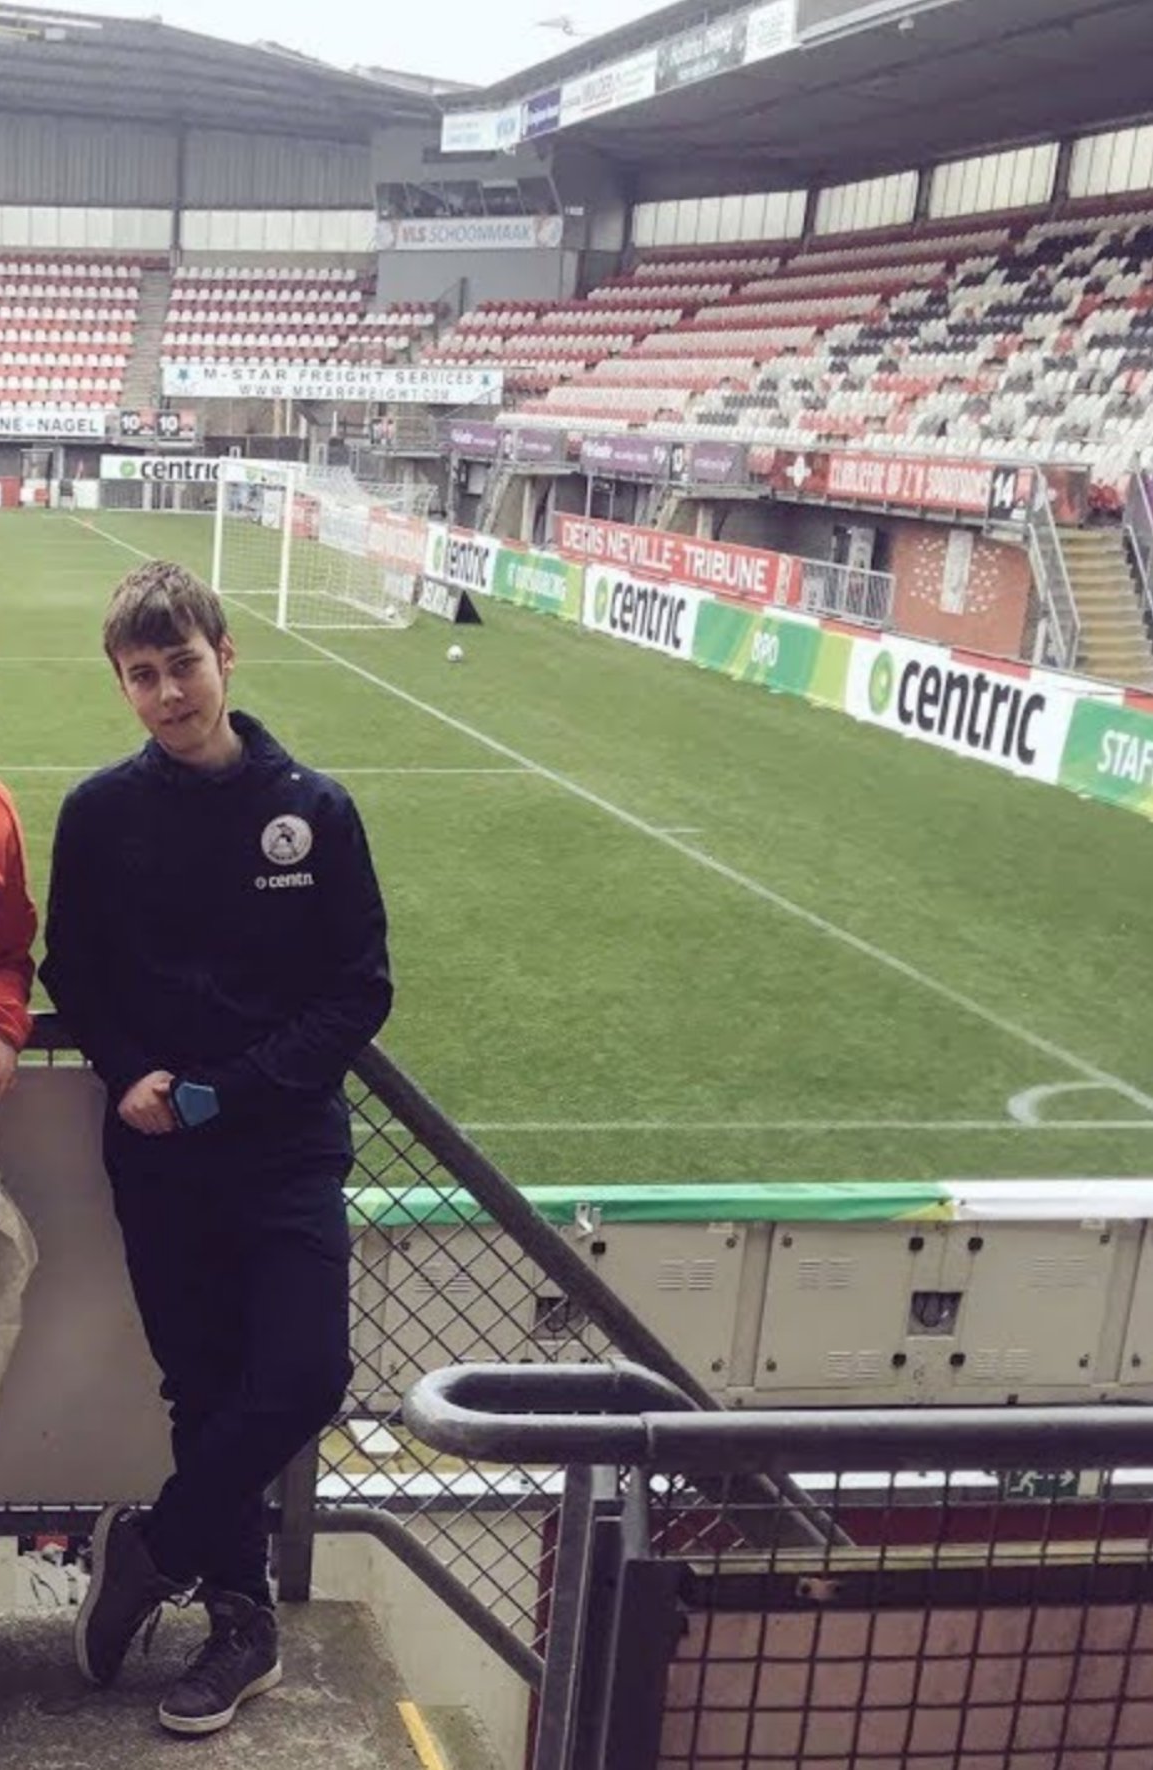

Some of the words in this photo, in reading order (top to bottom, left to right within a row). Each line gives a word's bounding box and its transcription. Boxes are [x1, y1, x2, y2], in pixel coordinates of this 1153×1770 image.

[204, 368, 288, 380] M-STAR
[299, 370, 383, 383] FREIGHT
[396, 372, 474, 385] SERVICES
[37, 418, 99, 433] NAGEL
[122, 412, 140, 431] 10
[159, 414, 178, 432] 10
[993, 472, 1016, 509] 14
[684, 543, 769, 594] TRIBUNE
[610, 582, 686, 650] centric
[897, 660, 1046, 766] centric
